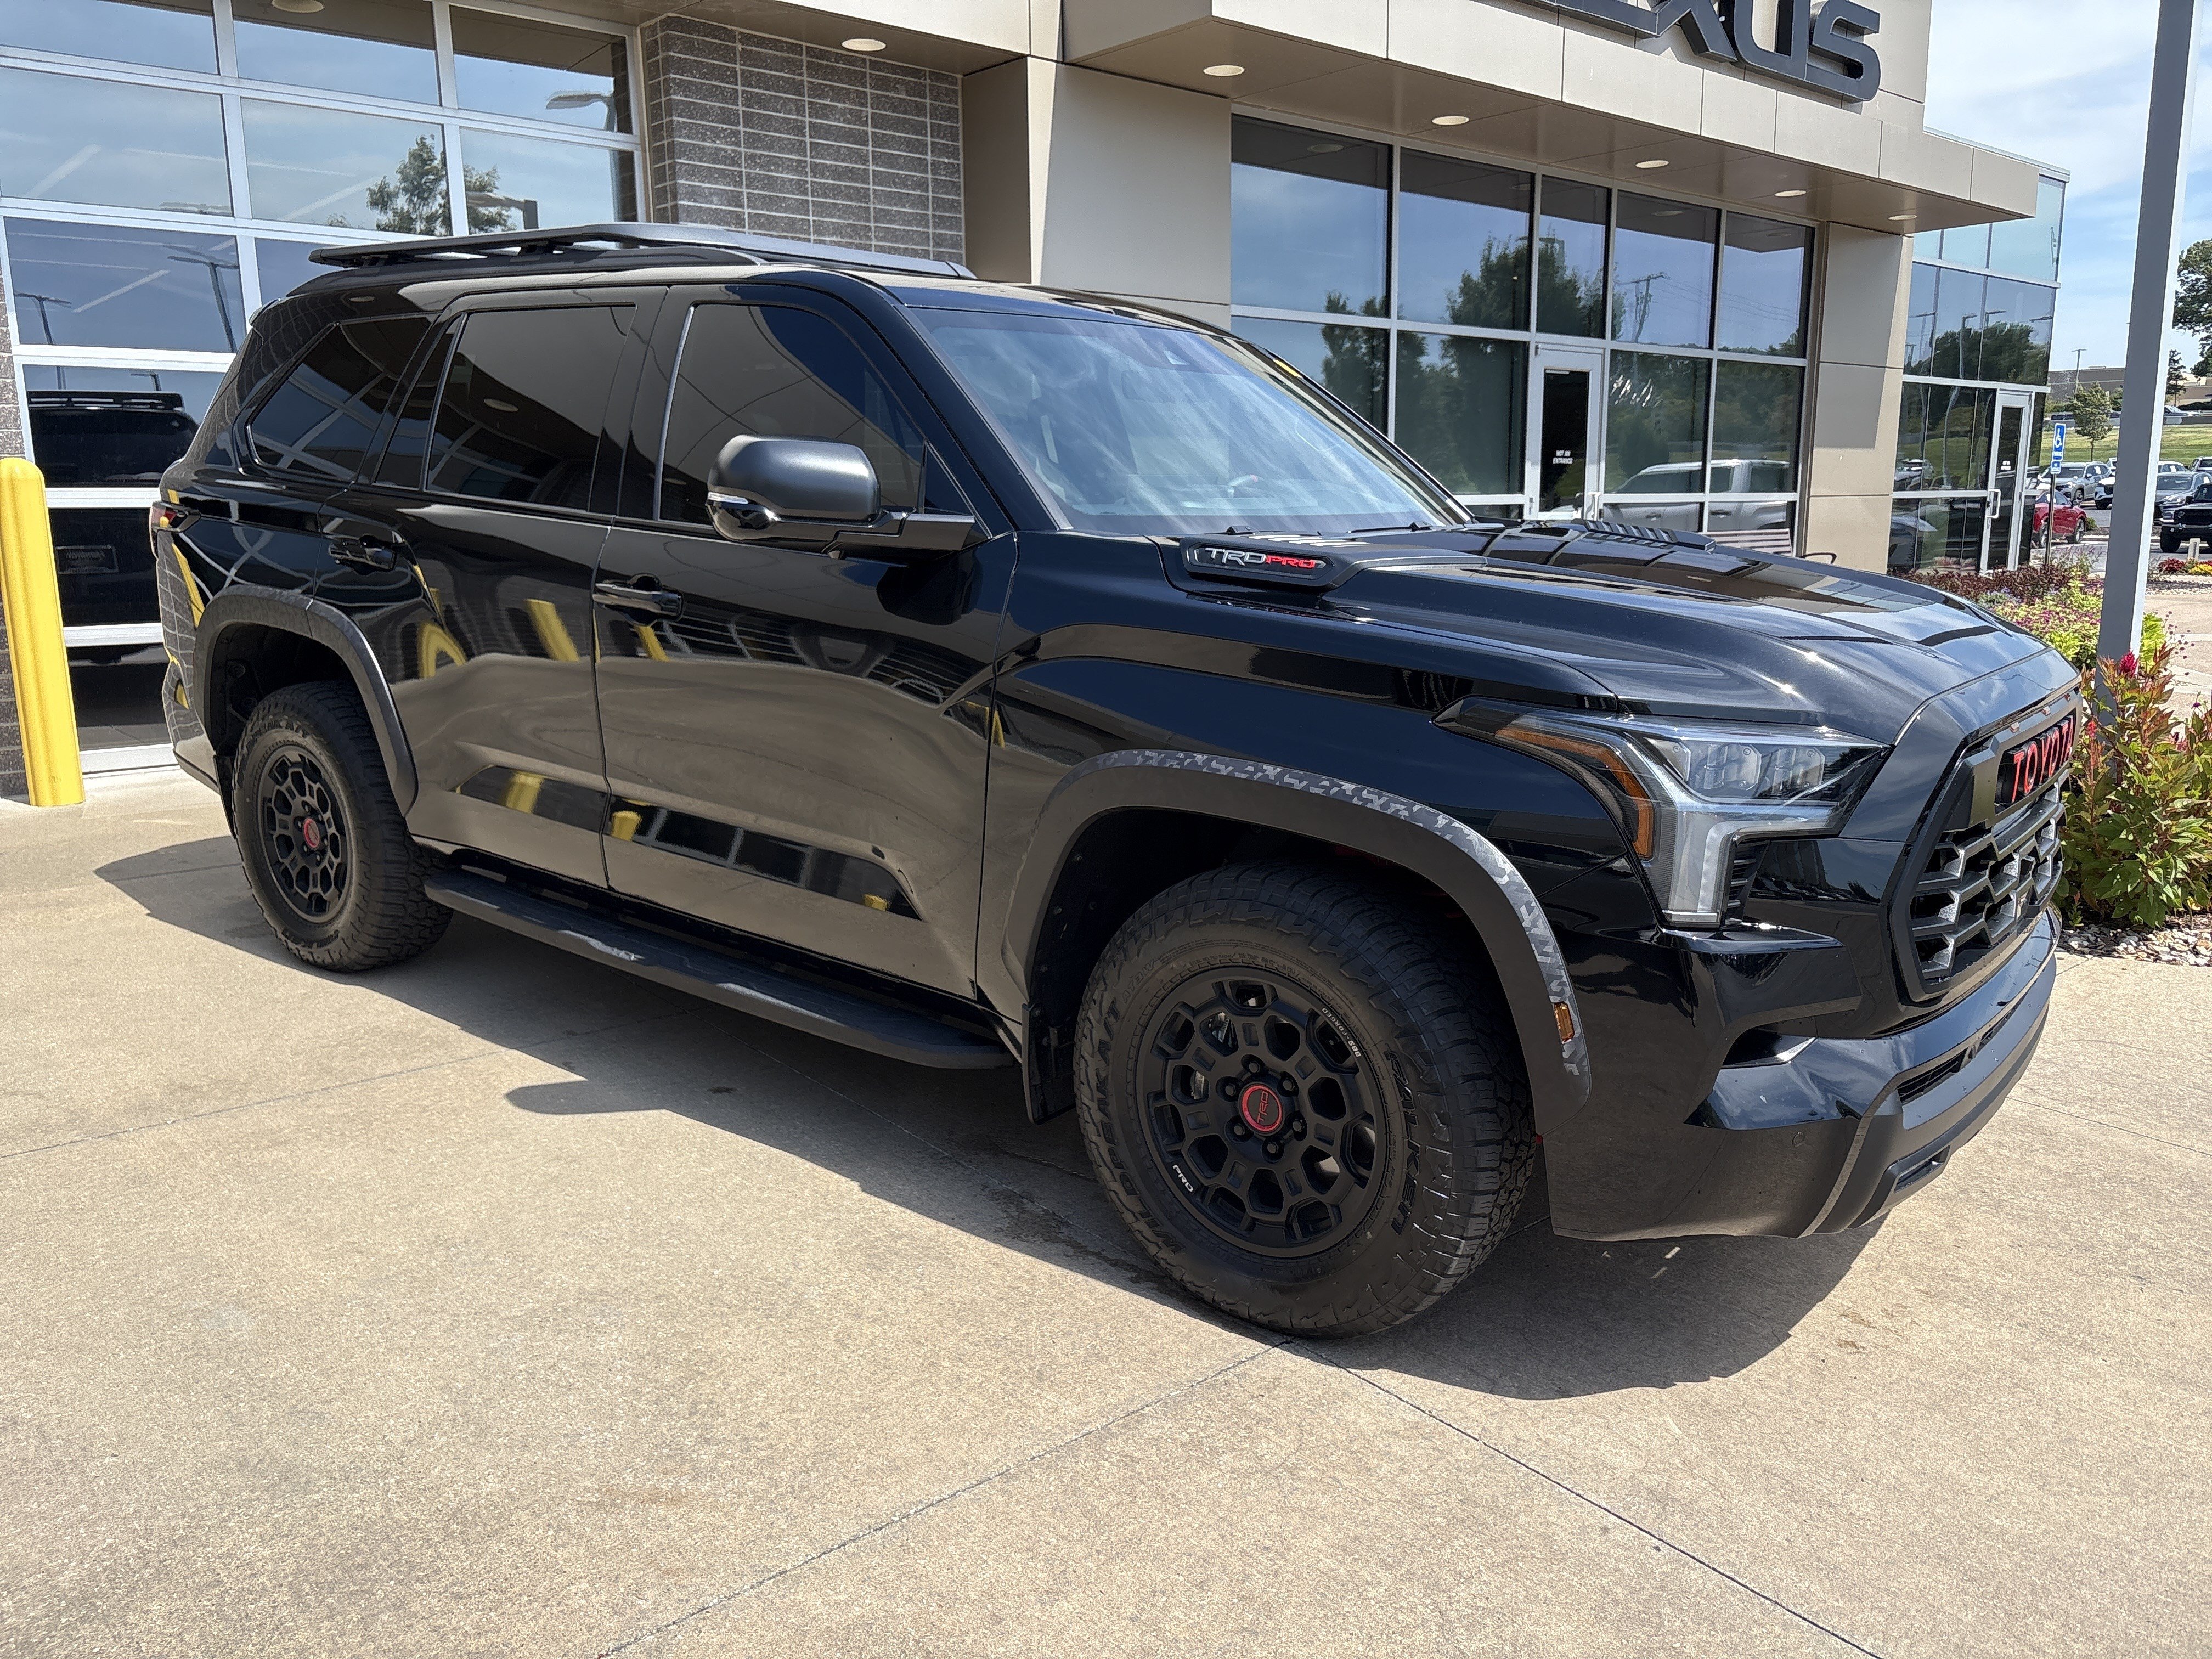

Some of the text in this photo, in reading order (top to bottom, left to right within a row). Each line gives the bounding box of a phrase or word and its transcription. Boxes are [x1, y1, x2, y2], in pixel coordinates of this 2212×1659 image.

[1543, 0, 1881, 102] XUS
[2008, 715, 2074, 804] TOYOTA
[1322, 1008, 1347, 1036] FORGED
[1256, 1091, 1269, 1124] TRD
[1172, 1164, 1194, 1192] PRO
